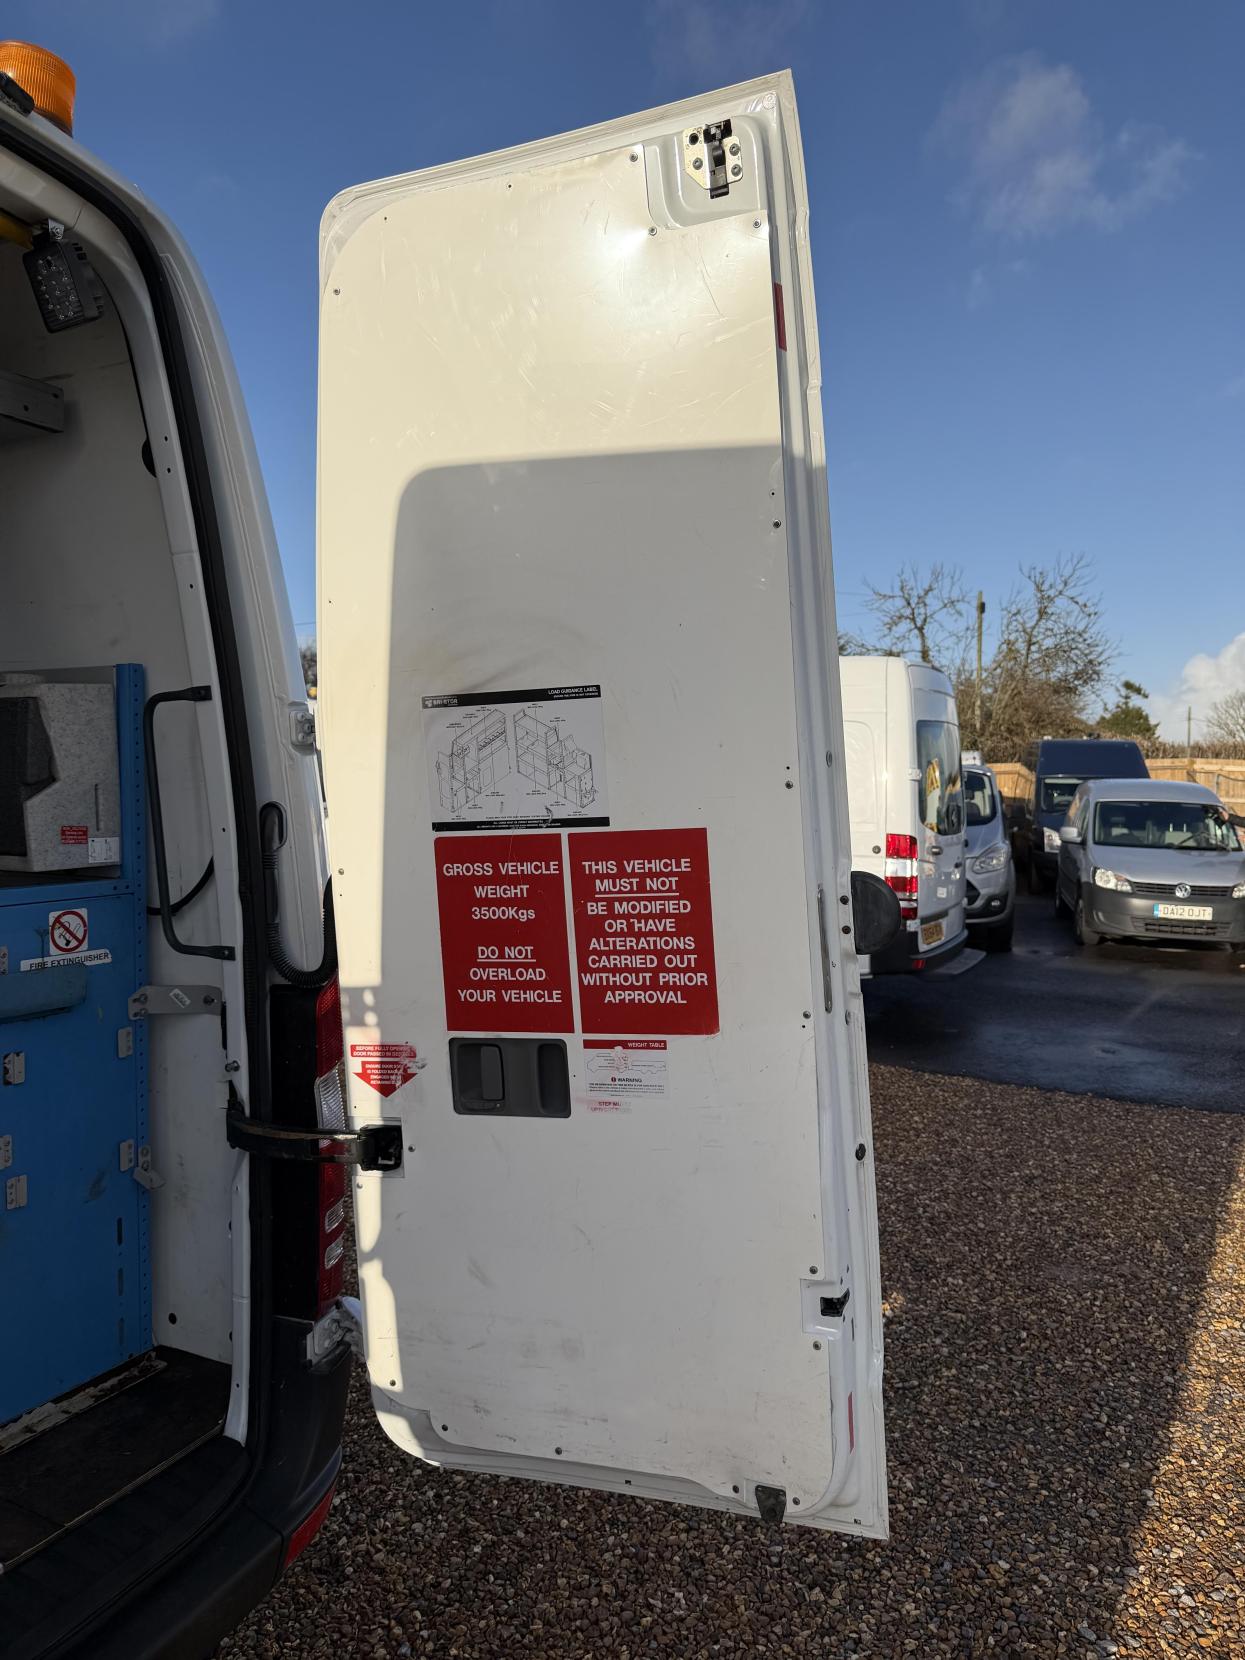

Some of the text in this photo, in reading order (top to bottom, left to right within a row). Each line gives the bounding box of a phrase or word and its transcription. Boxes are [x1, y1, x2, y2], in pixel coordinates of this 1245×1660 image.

[443, 861, 559, 876] GROSS VEHICLE
[582, 858, 691, 874] THIS VEHICLE
[595, 877, 679, 892] MUST NOT
[474, 885, 529, 898] WEIGHT
[471, 907, 535, 921] 3500Kgs
[587, 900, 691, 915] BE MODIFIED
[605, 919, 676, 932] OR HAVE
[589, 937, 695, 950] ALTERATIONS
[477, 946, 534, 959] DO NOT
[29, 952, 109, 970] FIRE EXTINGUISHER
[588, 955, 698, 968] CARRIED OUT
[470, 968, 546, 981] OVERLOAD
[581, 973, 708, 986] WITHOUT PRIOR
[458, 989, 562, 1003] YOUR VEHICLE
[604, 991, 687, 1004] APPROVAL
